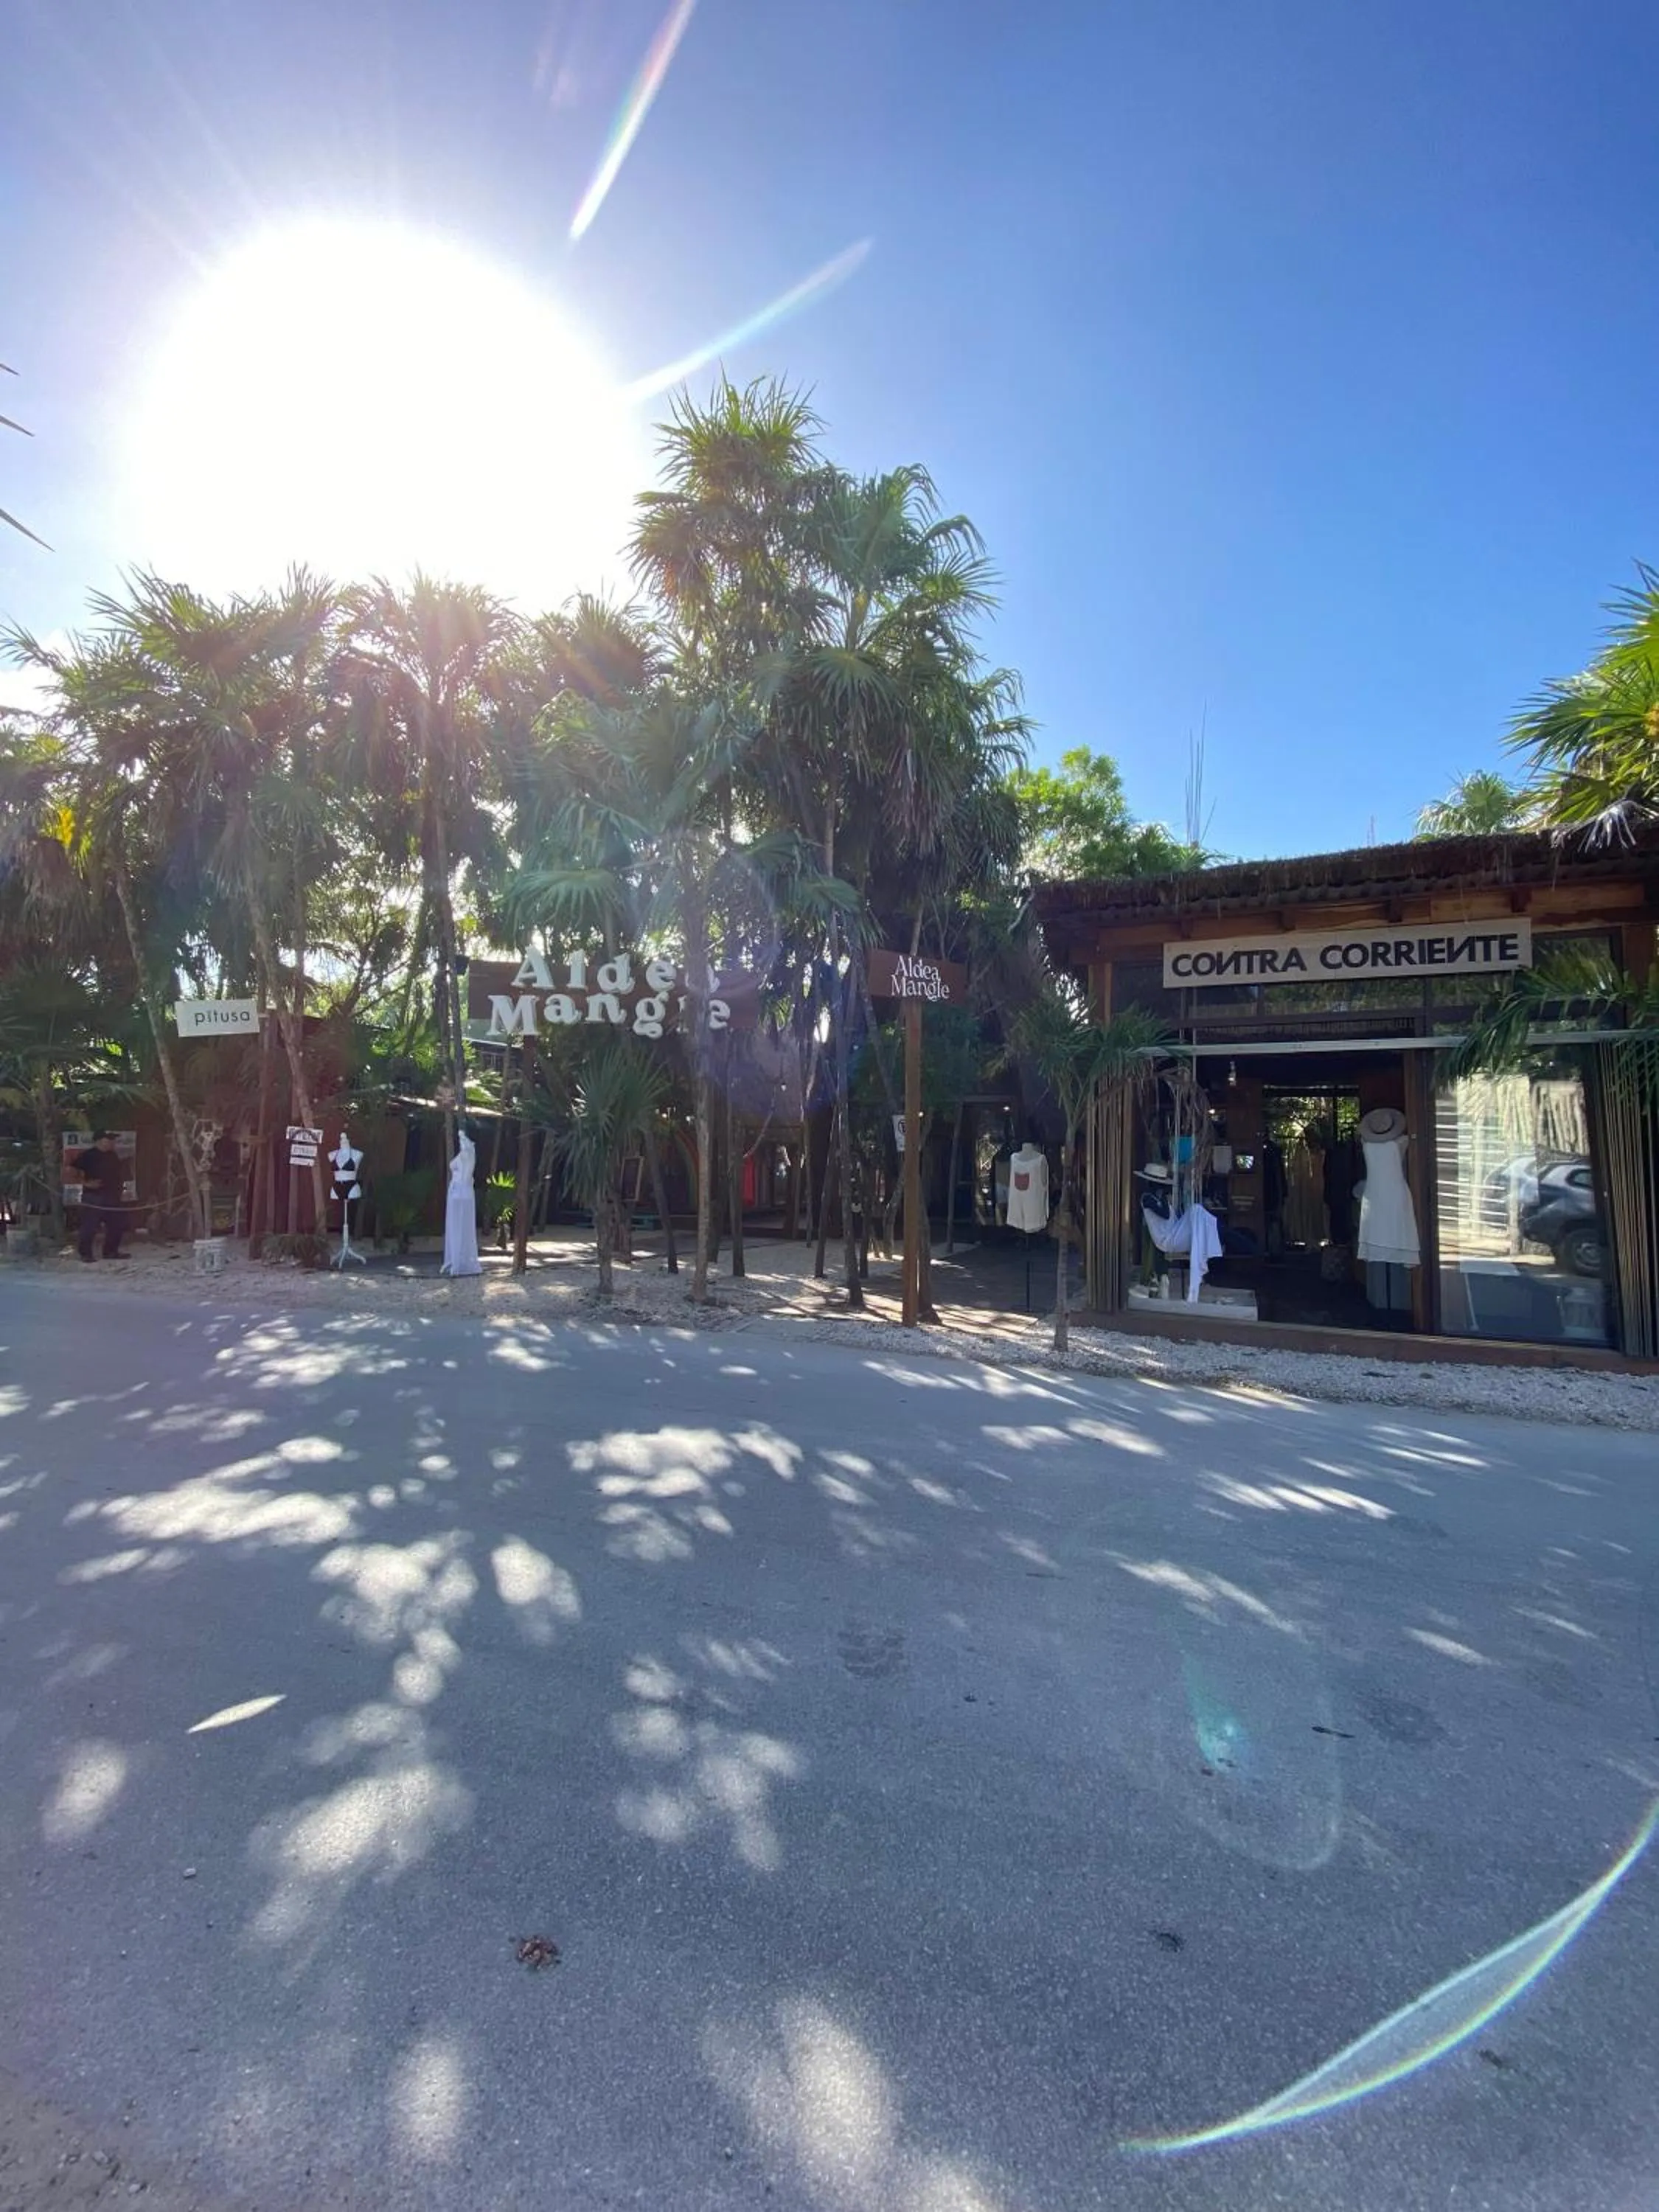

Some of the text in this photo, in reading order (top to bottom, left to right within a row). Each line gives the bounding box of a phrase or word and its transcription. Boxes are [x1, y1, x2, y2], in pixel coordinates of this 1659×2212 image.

[895, 955, 939, 981] Aldea
[891, 974, 950, 1002] Mangle
[194, 1009, 250, 1026] pitusa
[487, 992, 731, 1038] Mange
